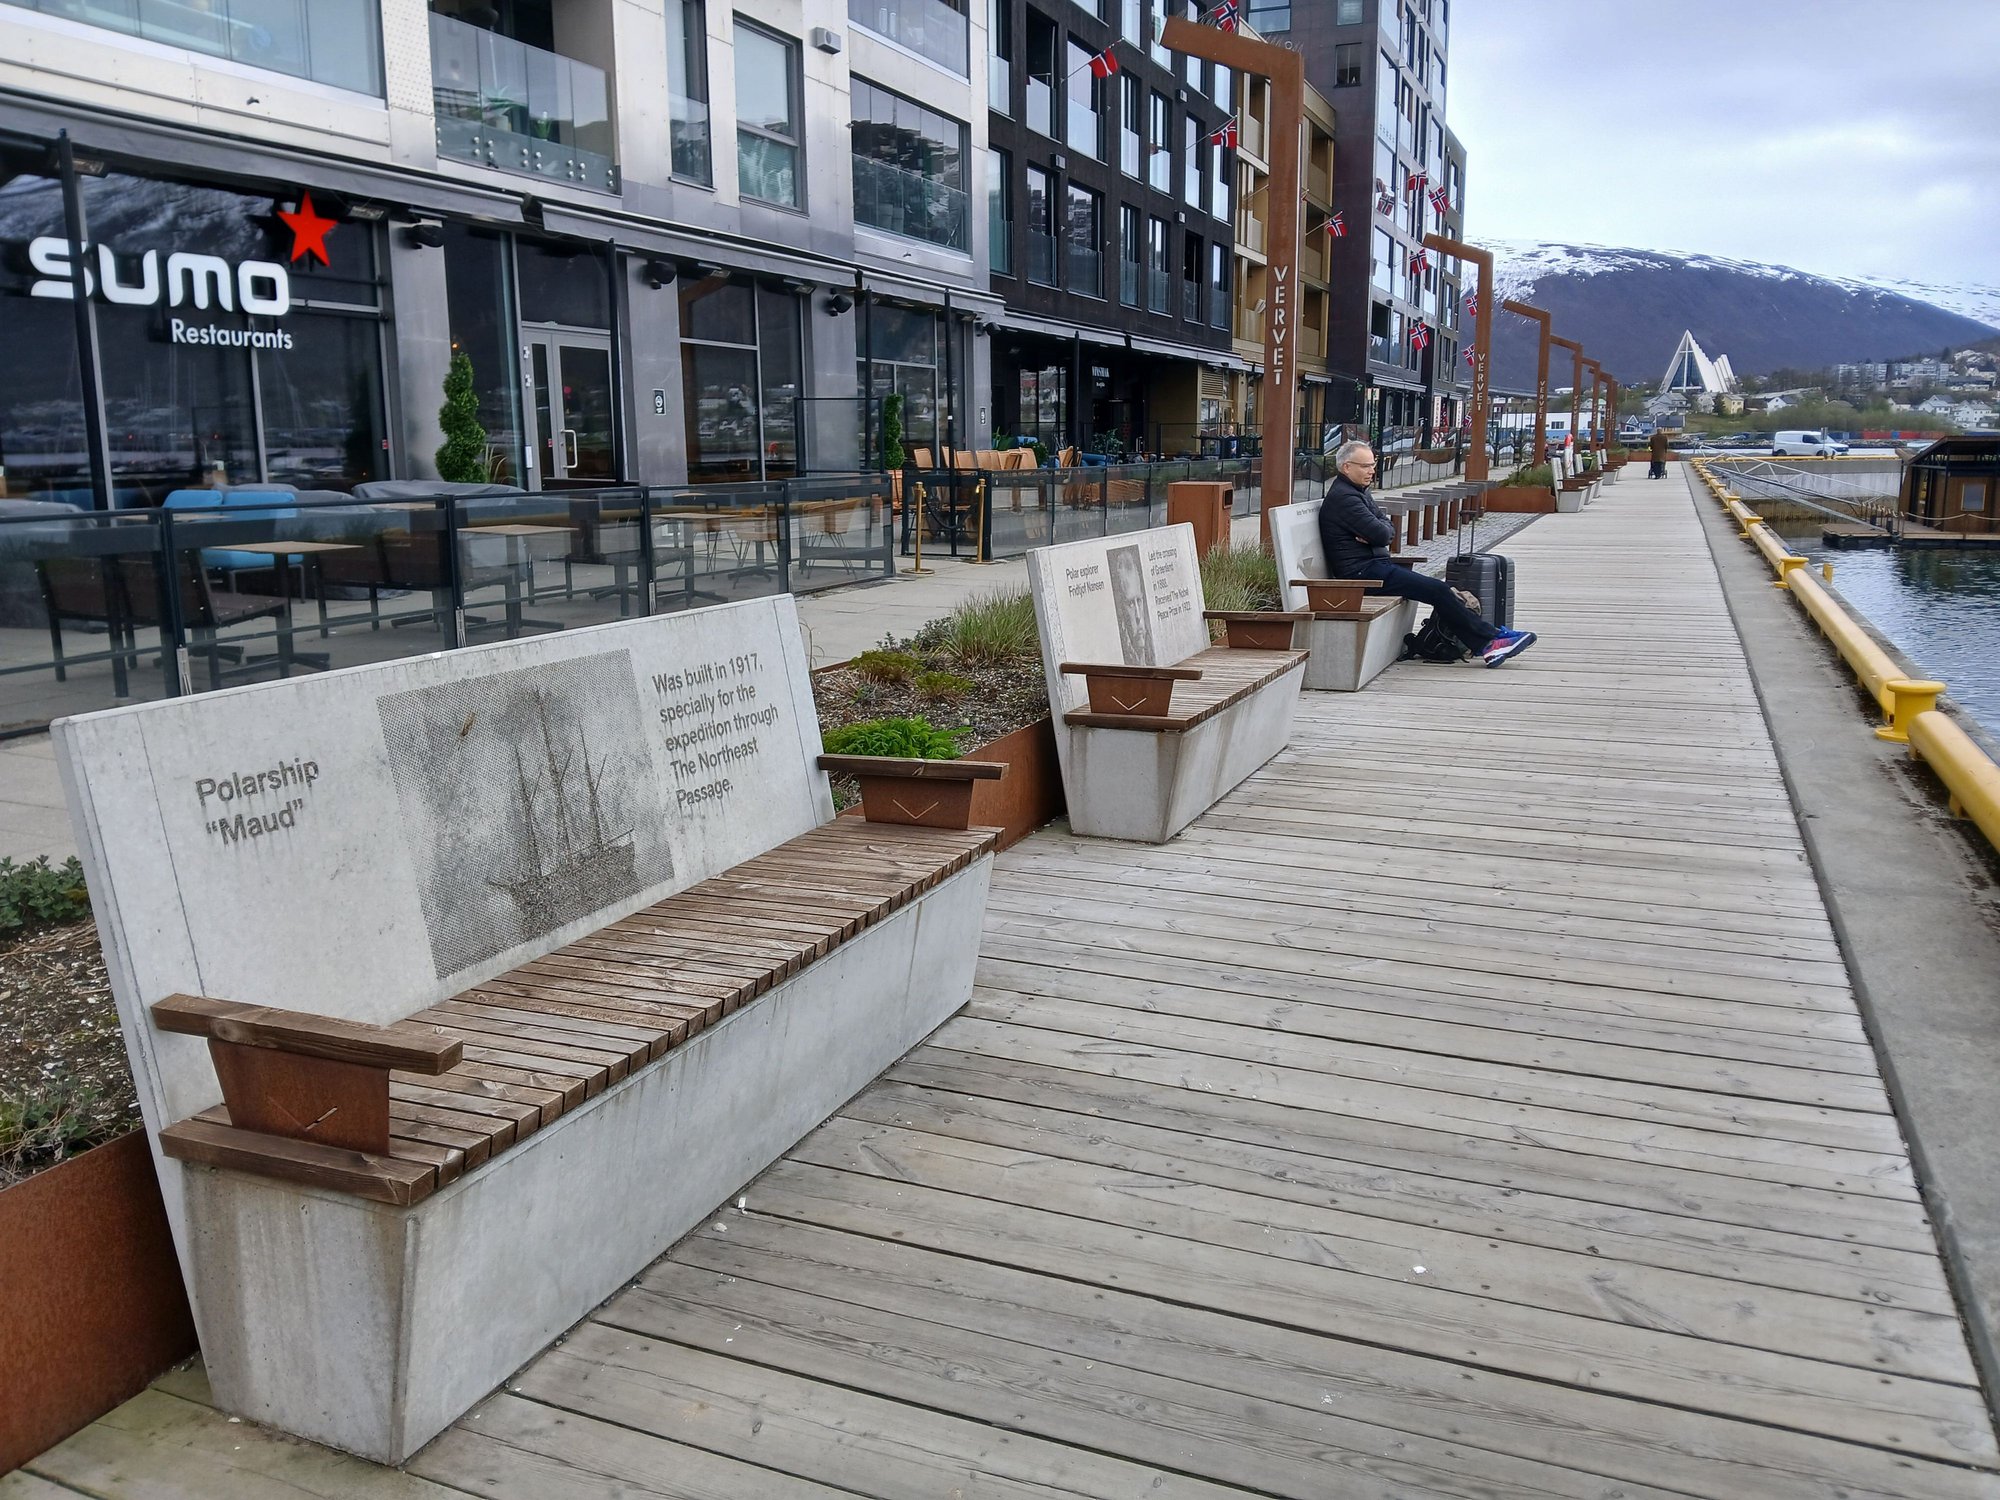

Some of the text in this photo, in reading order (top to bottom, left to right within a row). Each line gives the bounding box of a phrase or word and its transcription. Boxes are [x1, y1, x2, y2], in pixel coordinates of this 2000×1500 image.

[28, 236, 289, 316] SUMO
[171, 318, 293, 350] Restaurants
[1272, 265, 1288, 385] VERVET
[1477, 353, 1486, 411] VERVET
[1065, 564, 1099, 580] Polar explorer
[1087, 581, 1105, 593] Nansen
[652, 653, 764, 696] Was built in 1917,
[659, 683, 757, 726] specially for the
[665, 703, 779, 754] expedition through
[670, 736, 760, 781] The Northeast
[195, 757, 319, 807] Polarship
[676, 778, 734, 809] Passage.
